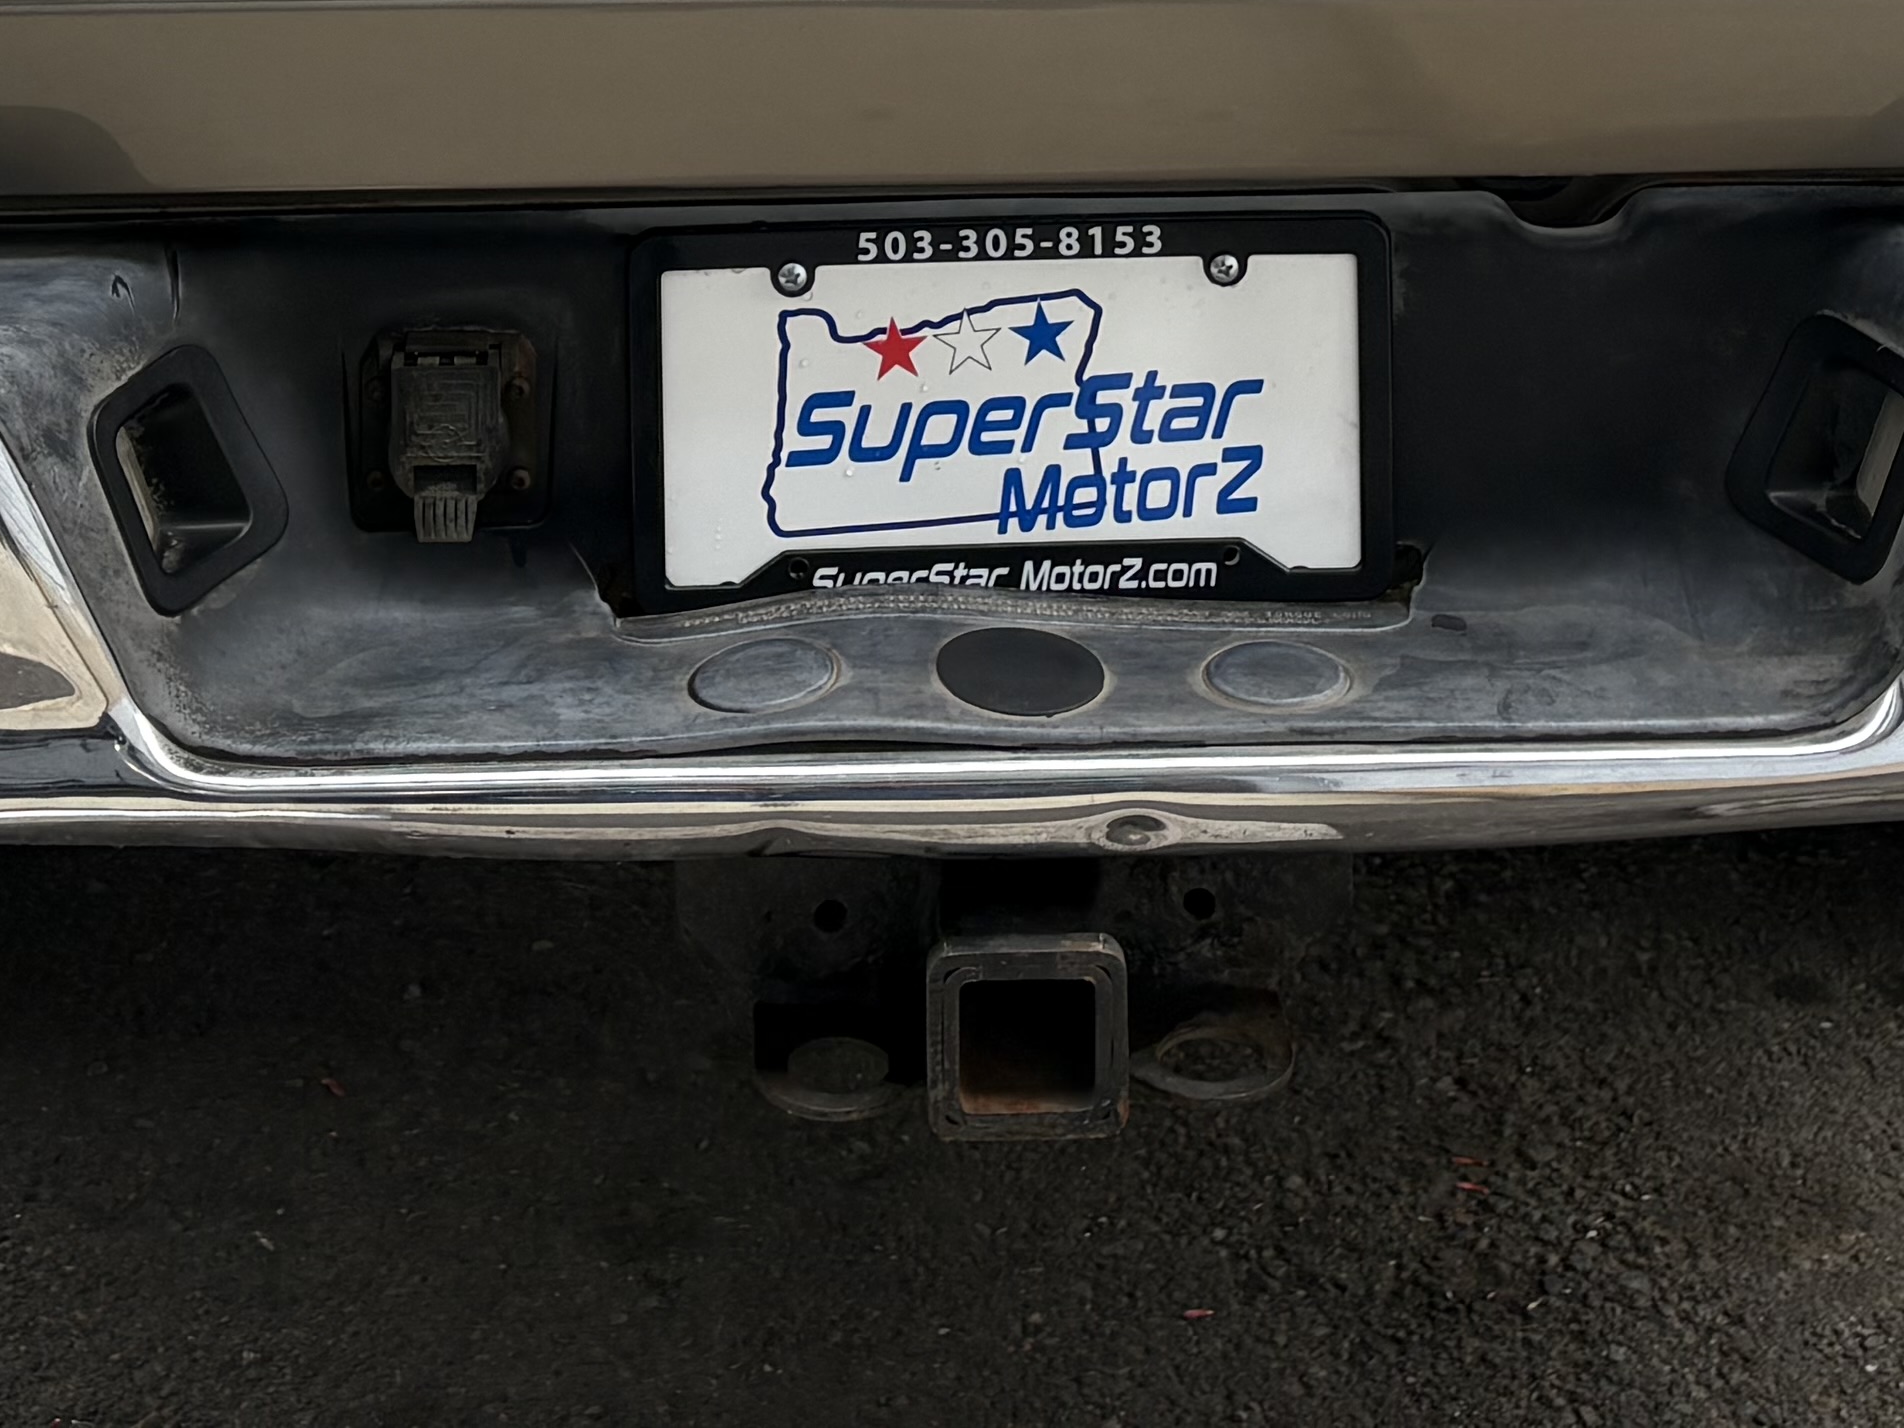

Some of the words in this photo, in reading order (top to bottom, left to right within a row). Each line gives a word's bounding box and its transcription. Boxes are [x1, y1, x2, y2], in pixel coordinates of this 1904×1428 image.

[856, 224, 1164, 262] 503-305-8153
[784, 370, 1265, 483] SuperStar
[998, 444, 1264, 535] MotorZ
[1019, 557, 1217, 591] MotorZ.com
